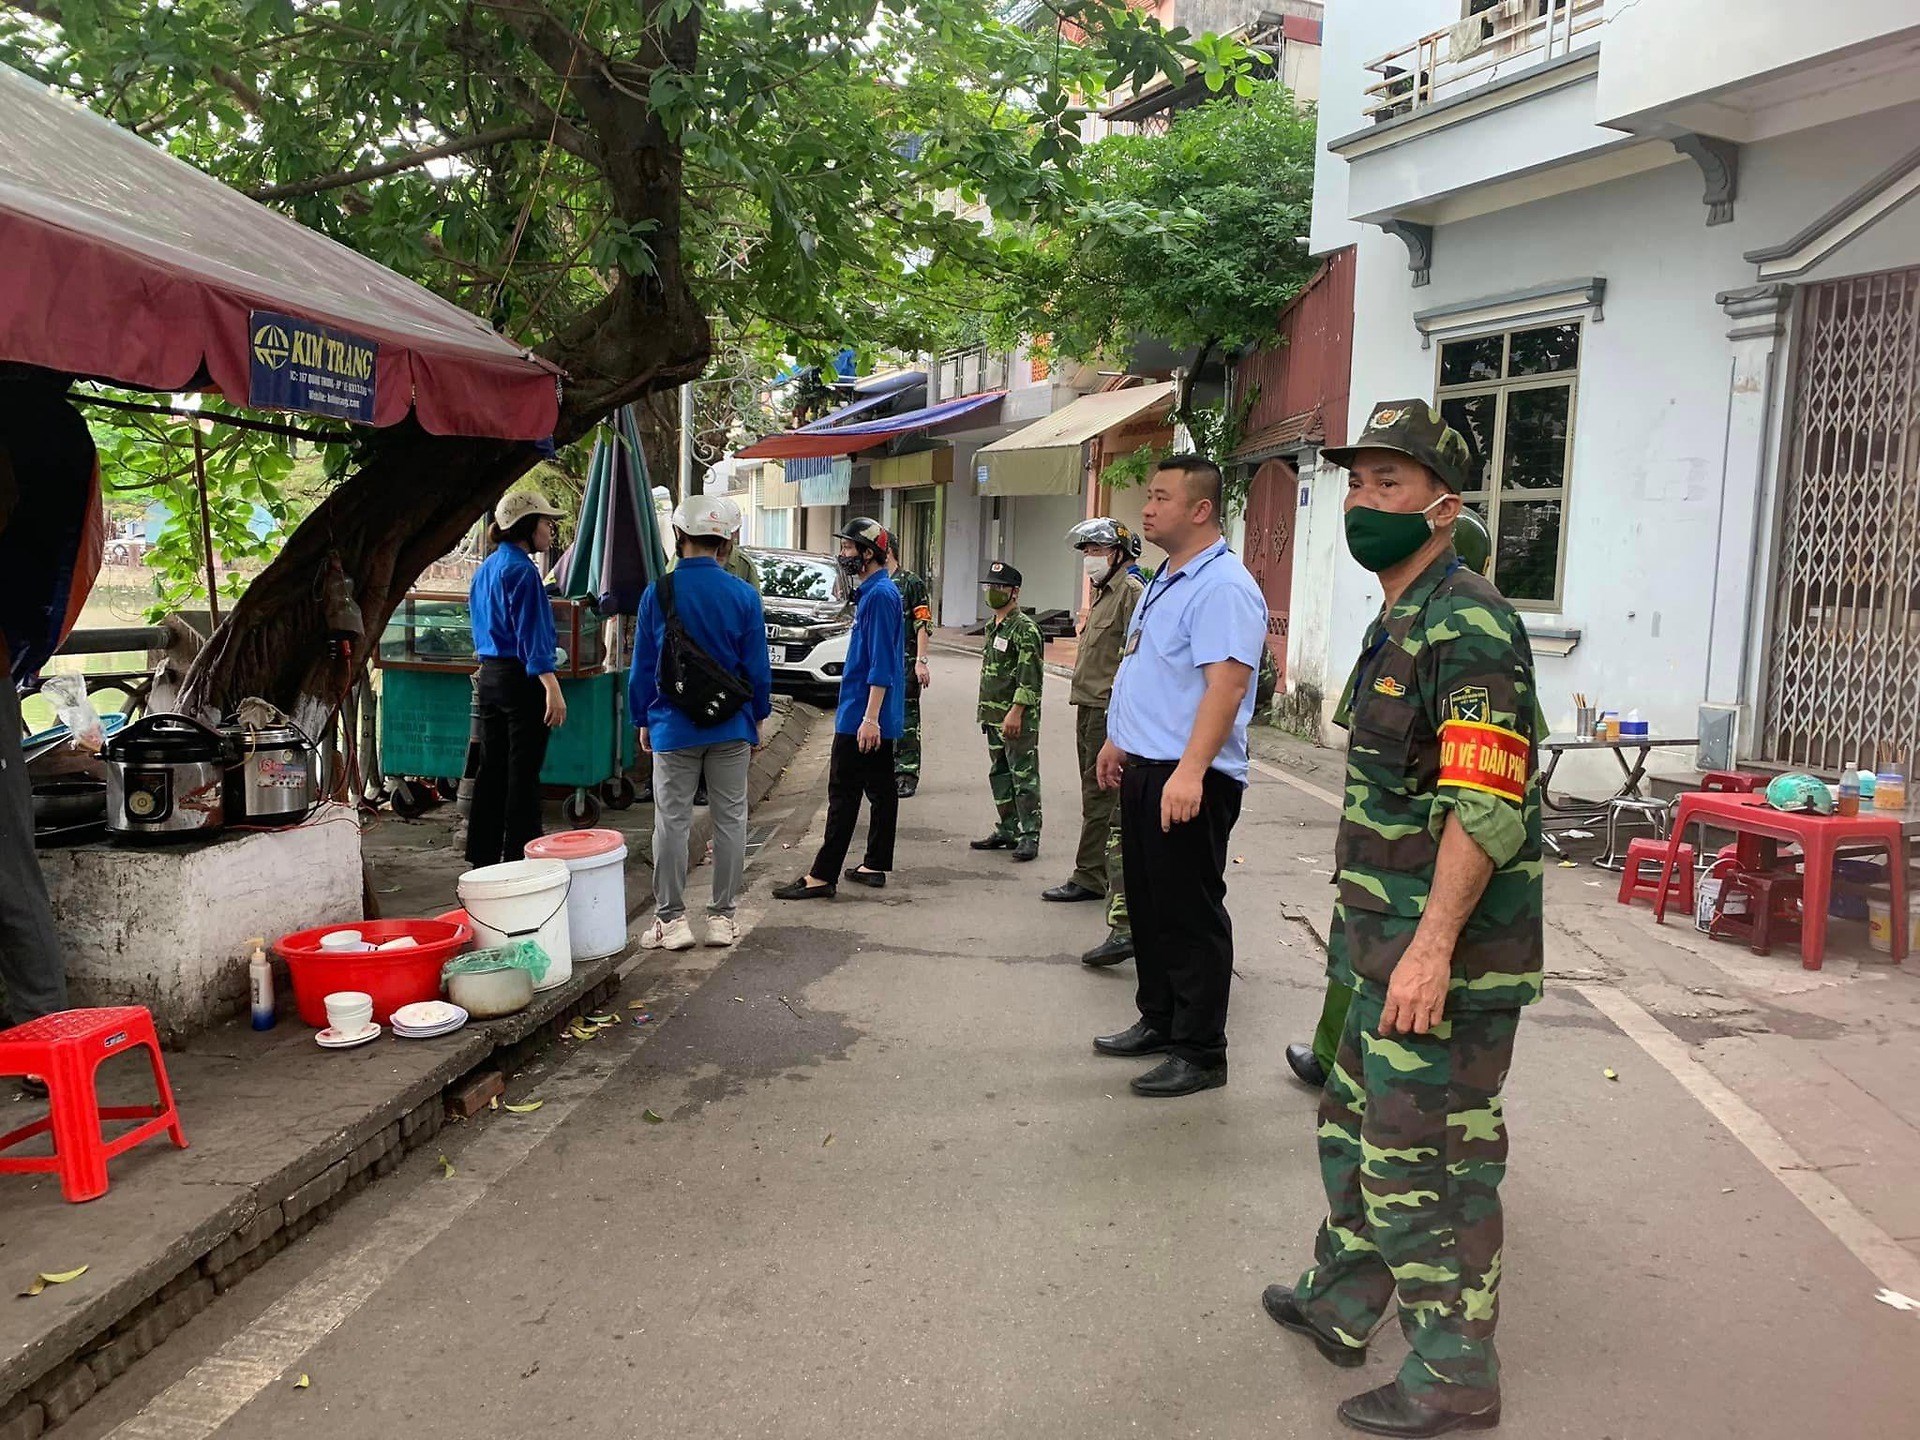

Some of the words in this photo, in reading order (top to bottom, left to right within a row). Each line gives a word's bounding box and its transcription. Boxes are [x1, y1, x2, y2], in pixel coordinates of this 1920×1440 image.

[291, 330, 323, 369] KIM
[326, 338, 373, 380] TRANG
[1440, 730, 1455, 769] ẢO
[1459, 737, 1476, 775] VỆ
[1479, 742, 1507, 776] DÂN
